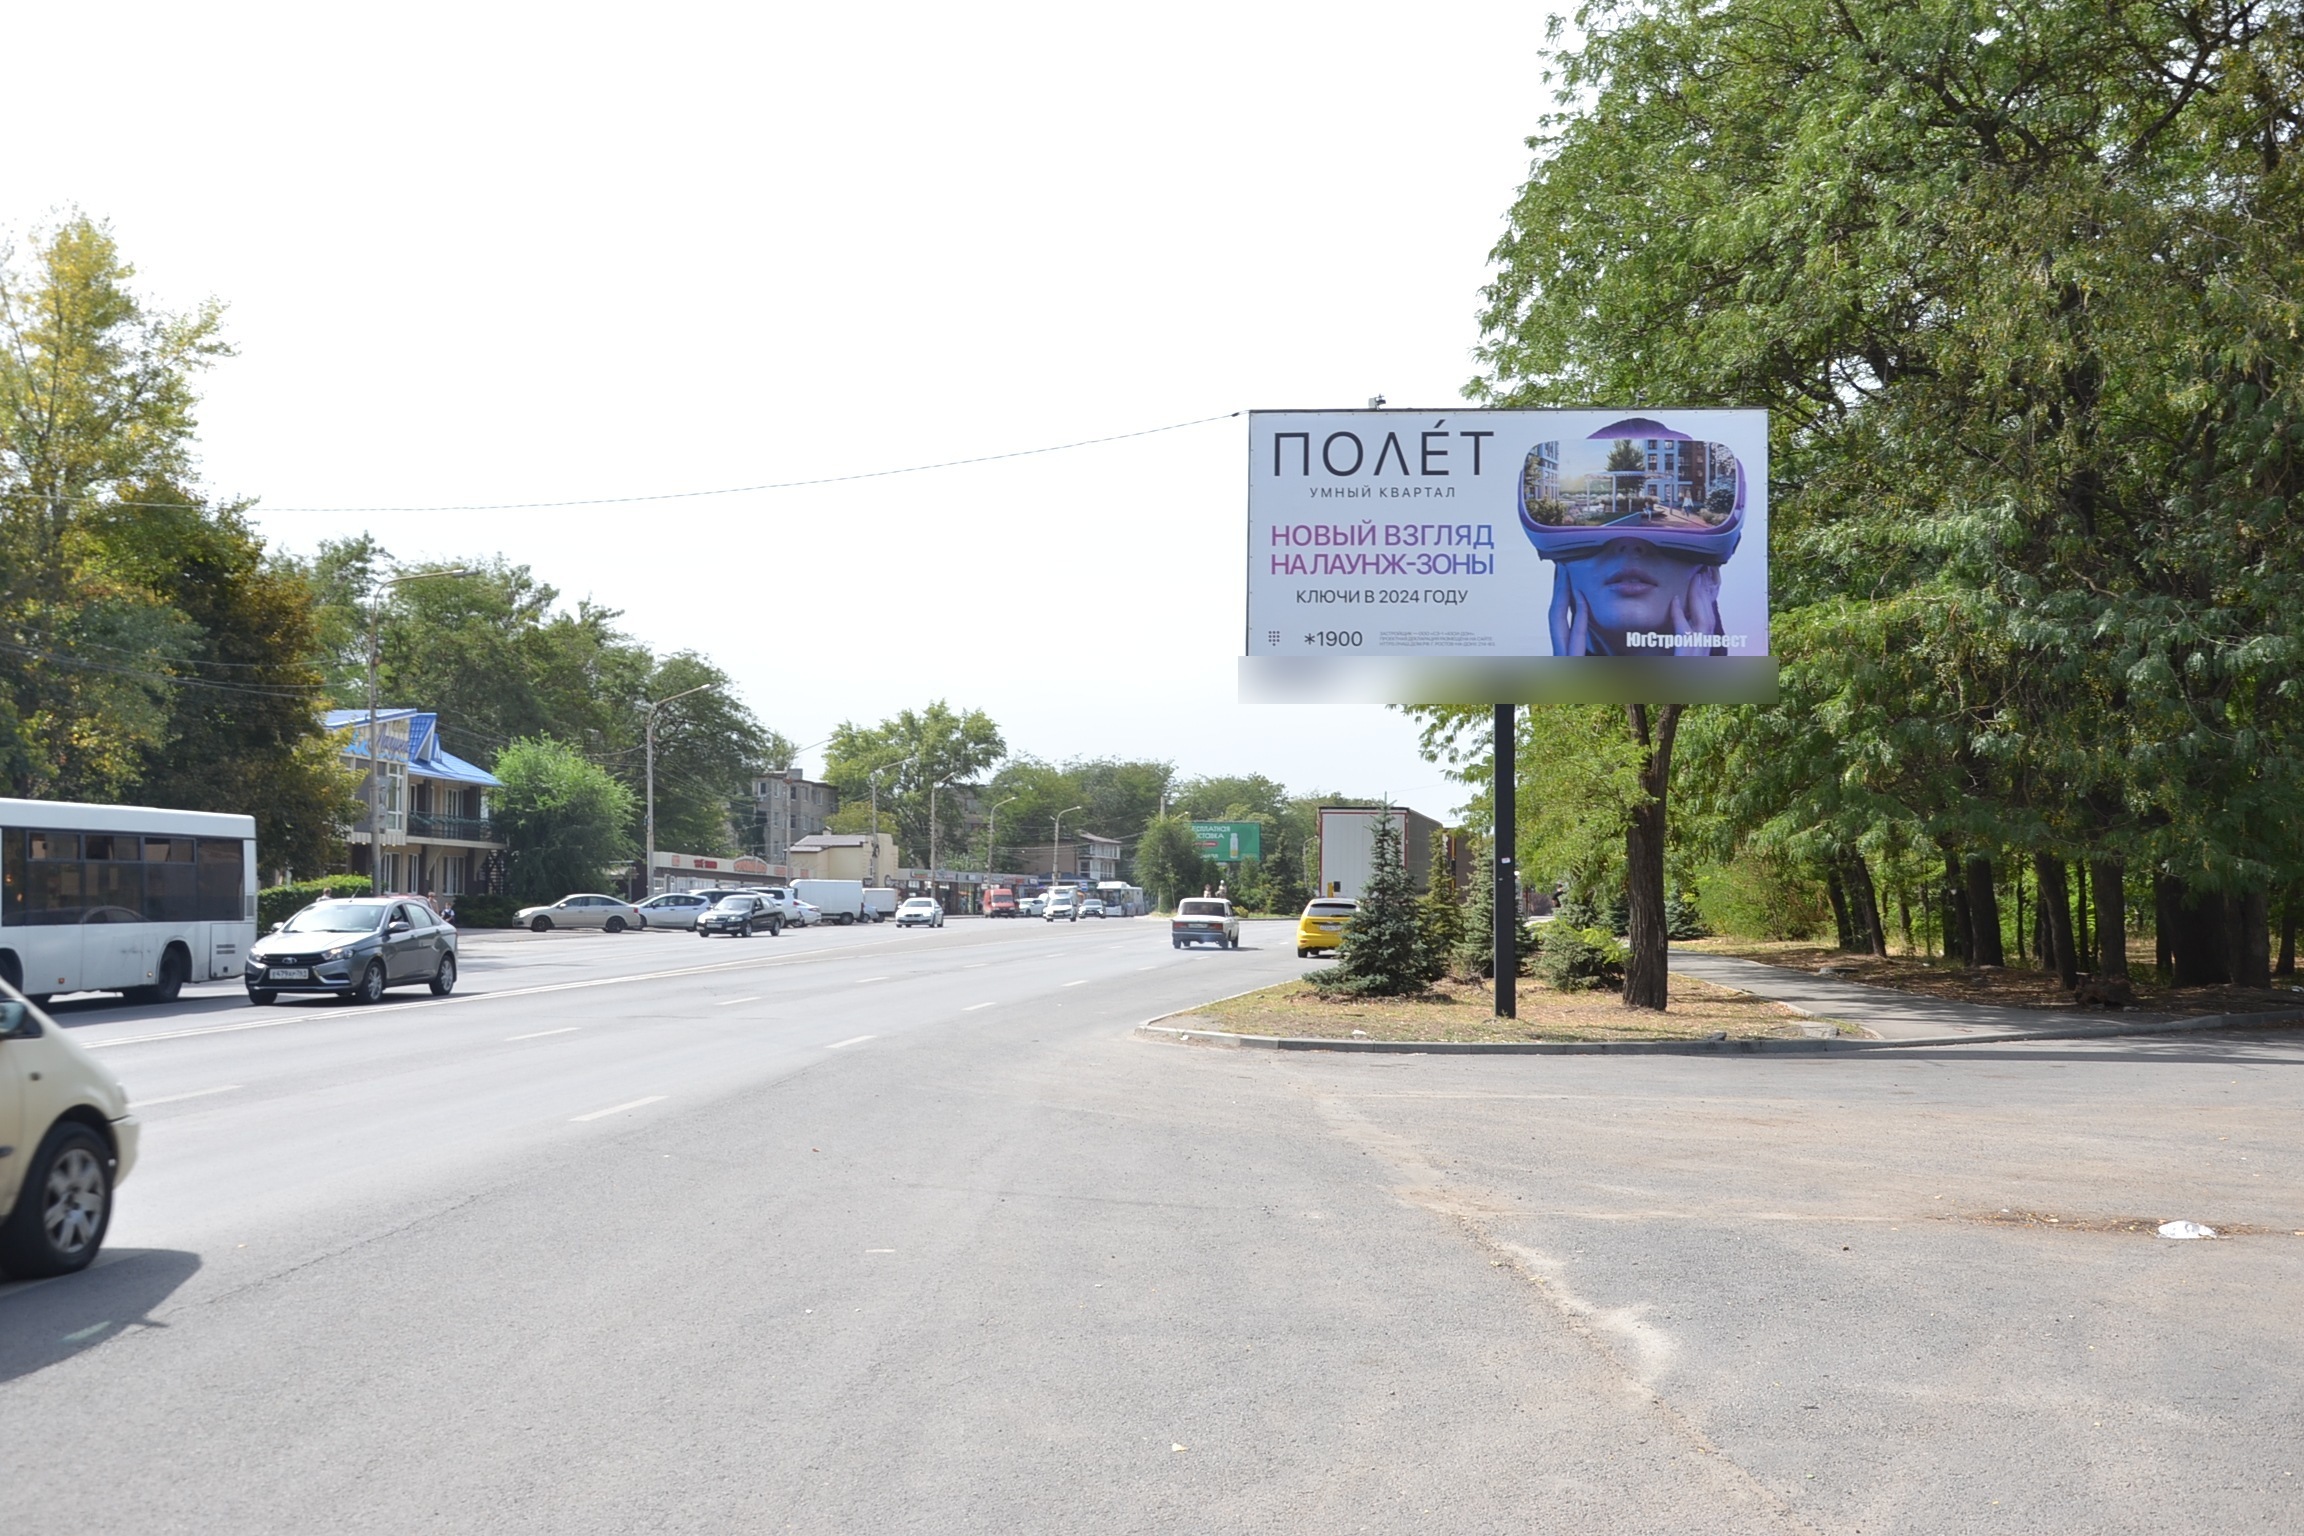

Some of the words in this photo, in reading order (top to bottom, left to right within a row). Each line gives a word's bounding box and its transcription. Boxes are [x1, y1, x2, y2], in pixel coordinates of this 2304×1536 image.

[1309, 485, 1372, 498] УМНЫЙ
[1379, 487, 1456, 498] КВАРТАЛ
[1271, 519, 1377, 547] НОВЫЙ
[1384, 524, 1495, 550] ВЗГЛЯД
[1271, 553, 1308, 575] НА
[1310, 553, 1494, 575] ЛАУНЖ-ЗОНЫ
[1296, 589, 1361, 603] КЛЮЧИ
[1364, 589, 1375, 603] В
[1379, 589, 1420, 603] 2024
[1424, 589, 1469, 606] ГОДУ
[1626, 631, 1748, 649] ЮгСтройИнвест
